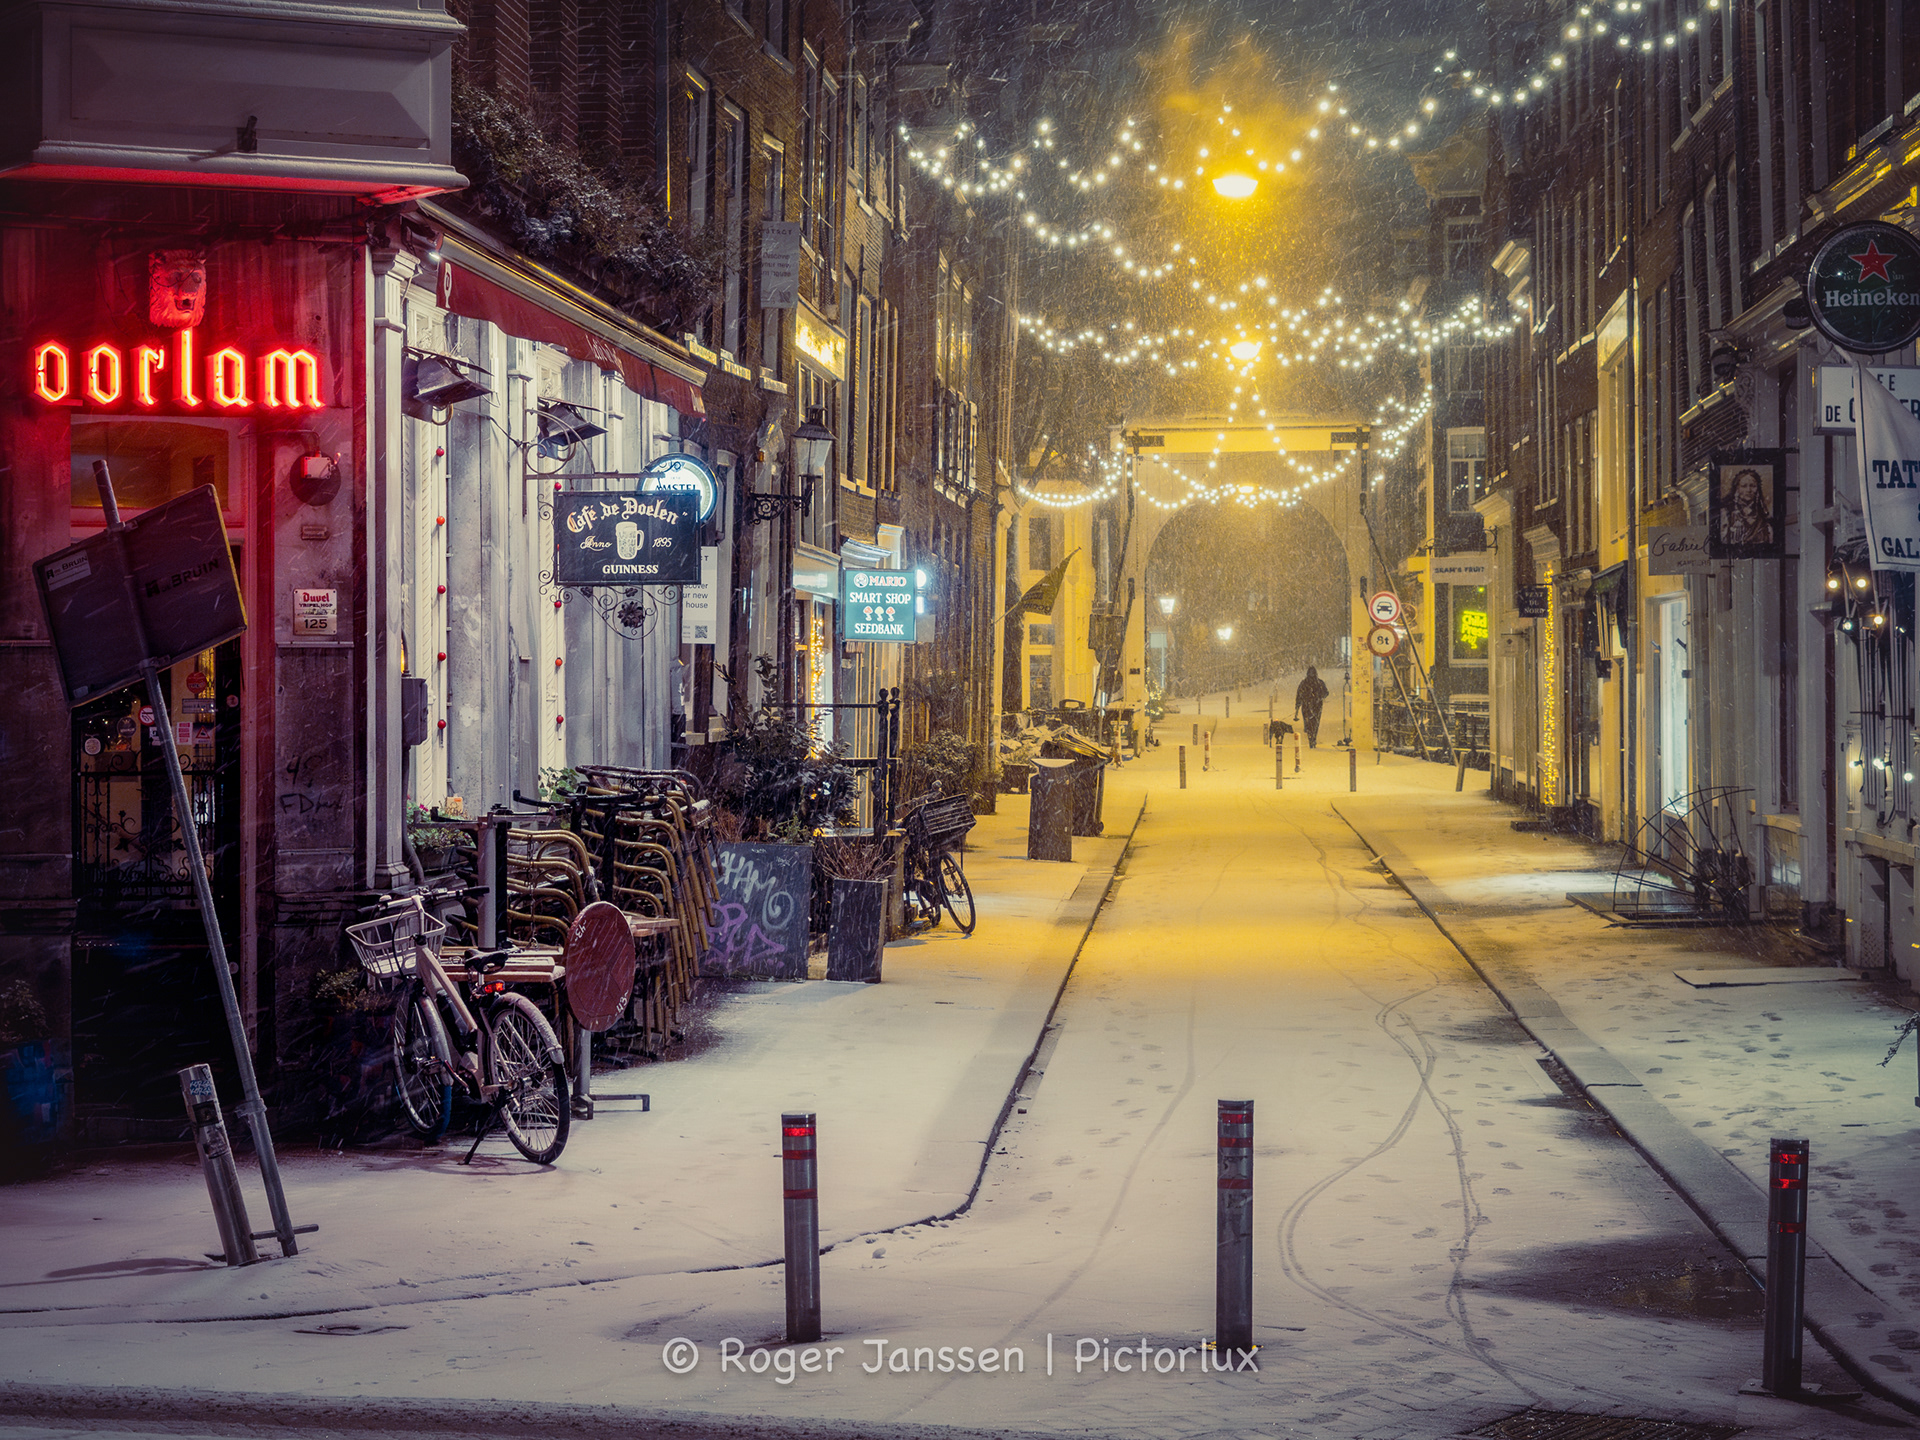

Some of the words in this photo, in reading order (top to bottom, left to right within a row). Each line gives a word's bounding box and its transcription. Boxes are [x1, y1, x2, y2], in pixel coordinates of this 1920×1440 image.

[1825, 288, 1920, 308] Heineken
[33, 326, 326, 409] oorlam
[1825, 405, 1841, 422] DE
[1872, 459, 1920, 489] TAT
[566, 504, 598, 533] Café
[580, 536, 612, 551] Anno
[652, 538, 672, 548] 1895
[1881, 536, 1920, 558] GAL
[172, 558, 219, 588] BRUIN
[602, 564, 659, 574] GUINNESS
[868, 576, 907, 587] MARIO
[302, 592, 330, 602] Duvel
[686, 600, 708, 608] house
[850, 592, 882, 604] SMART
[886, 593, 912, 604] SHOP
[304, 618, 328, 629] 125
[854, 622, 904, 635] SEEDBANK
[1376, 636, 1390, 646] 8t
